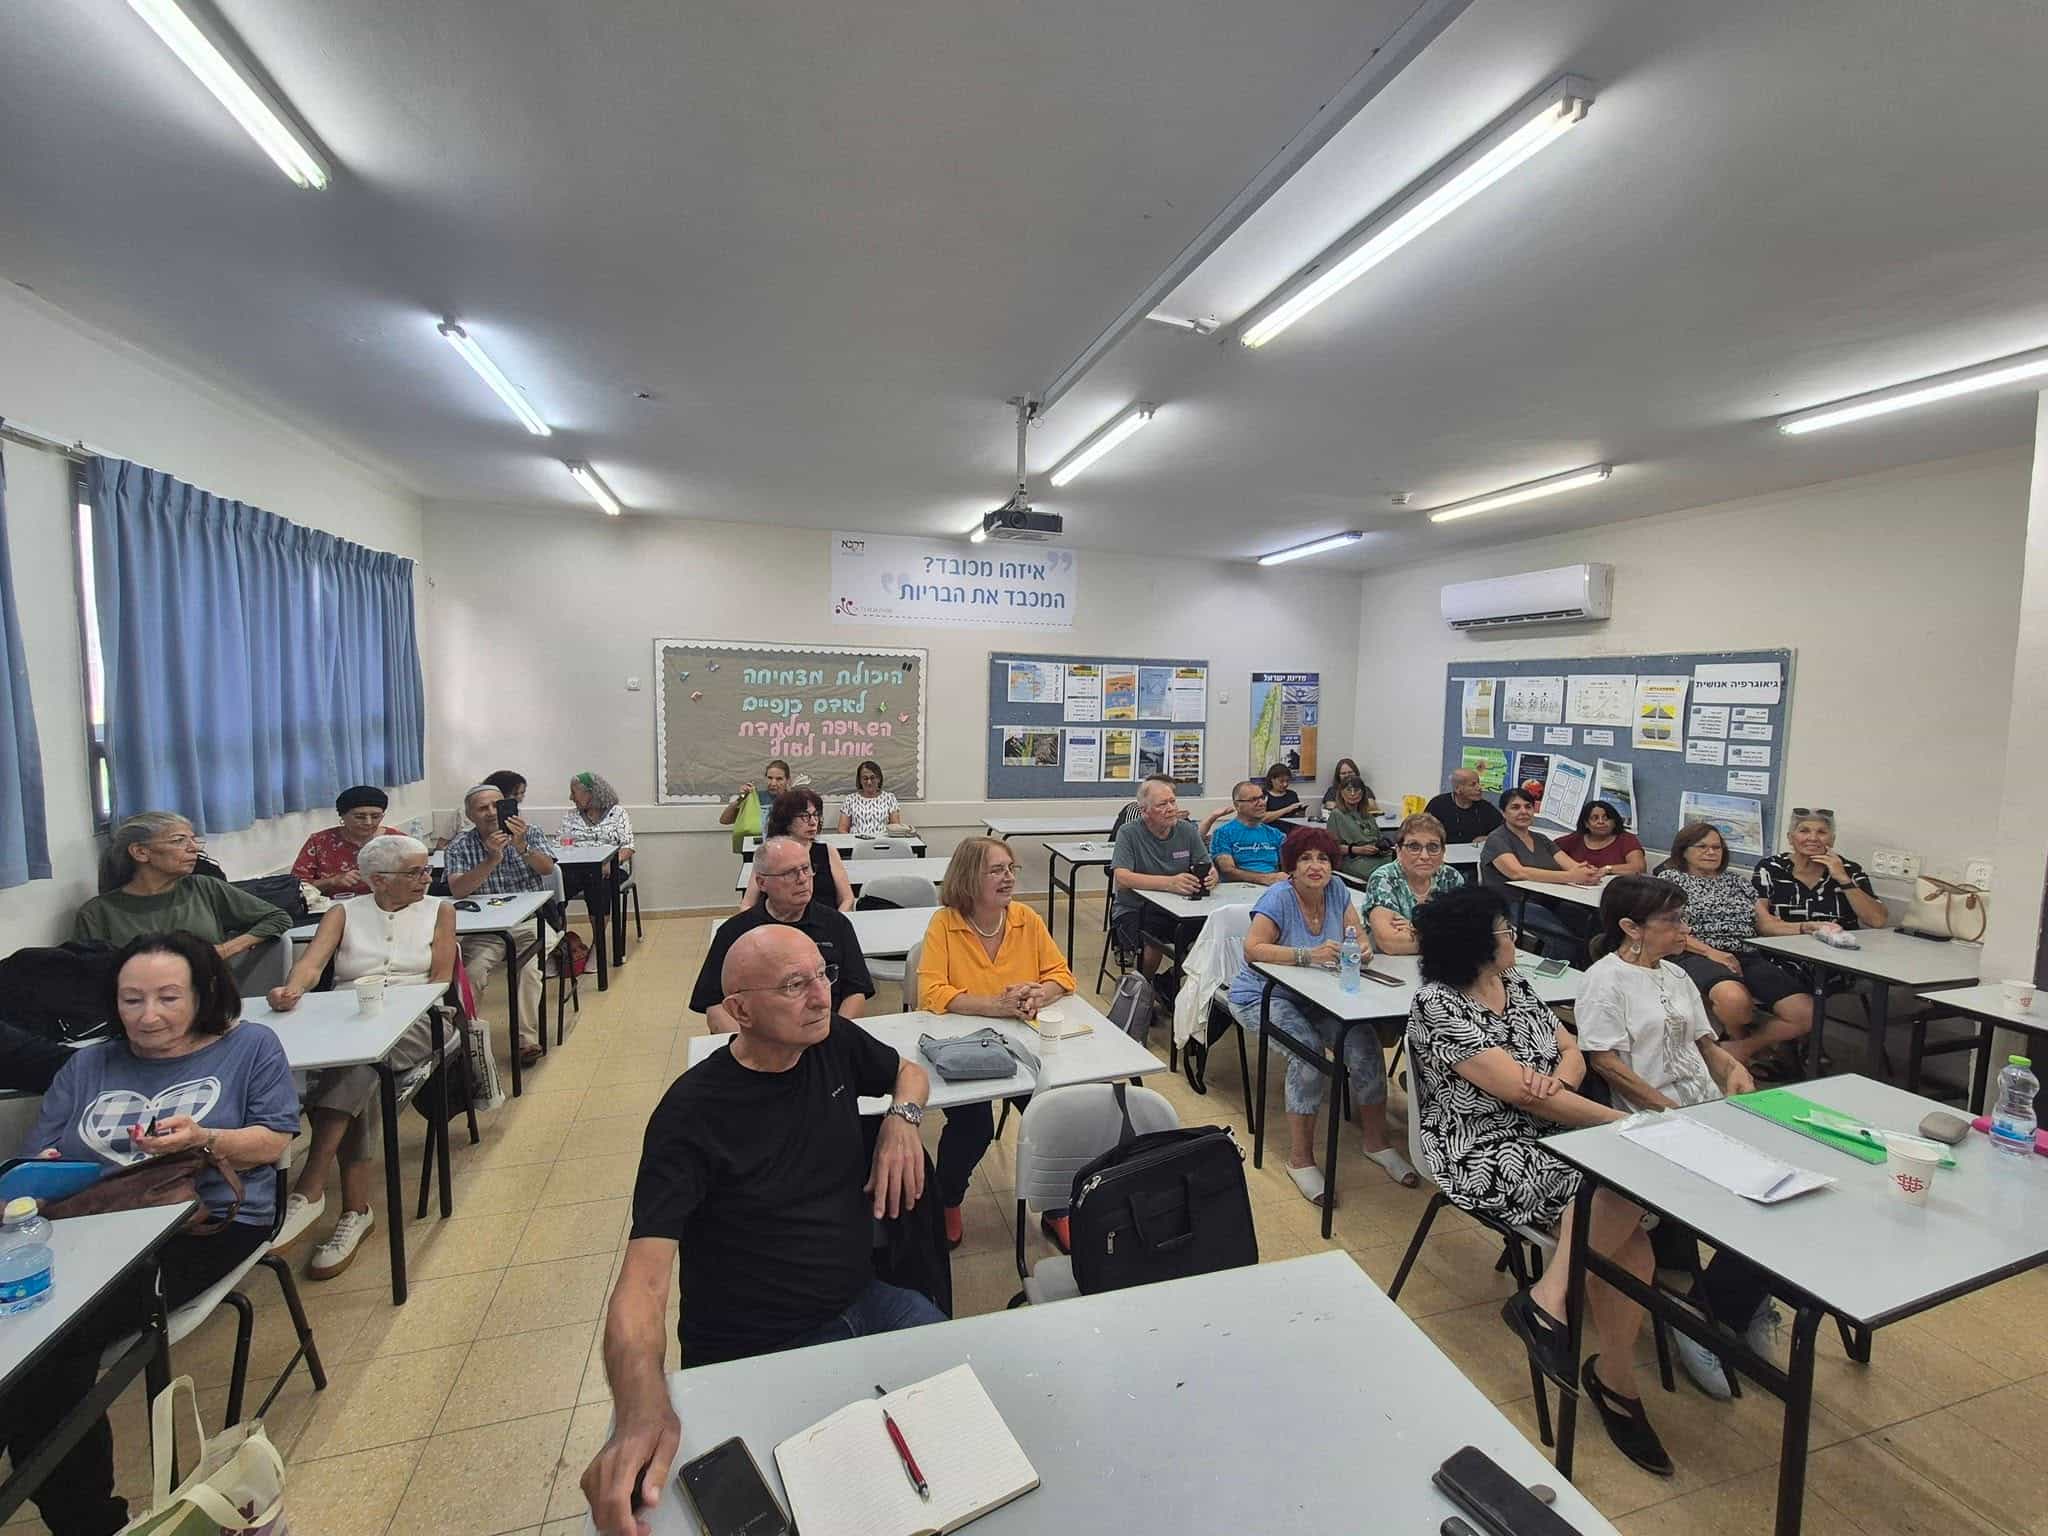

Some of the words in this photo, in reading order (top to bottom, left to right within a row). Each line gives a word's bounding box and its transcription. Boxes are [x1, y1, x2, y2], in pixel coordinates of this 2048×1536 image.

[923, 556, 993, 577] מכובד?
[999, 562, 1045, 580] איזהו
[899, 583, 965, 603] הבריות
[971, 588, 998, 605] את
[1004, 590, 1065, 608] המכבד
[744, 667, 823, 687] מצמיחה
[1696, 680, 1728, 689] אנושית
[1730, 679, 1778, 689] גיאוגרפיה
[742, 696, 804, 717] כנפיים
[814, 690, 868, 714] לאדם
[738, 714, 811, 737] מלמדת
[823, 719, 893, 737] השאיפה
[821, 739, 874, 757] אותנו
